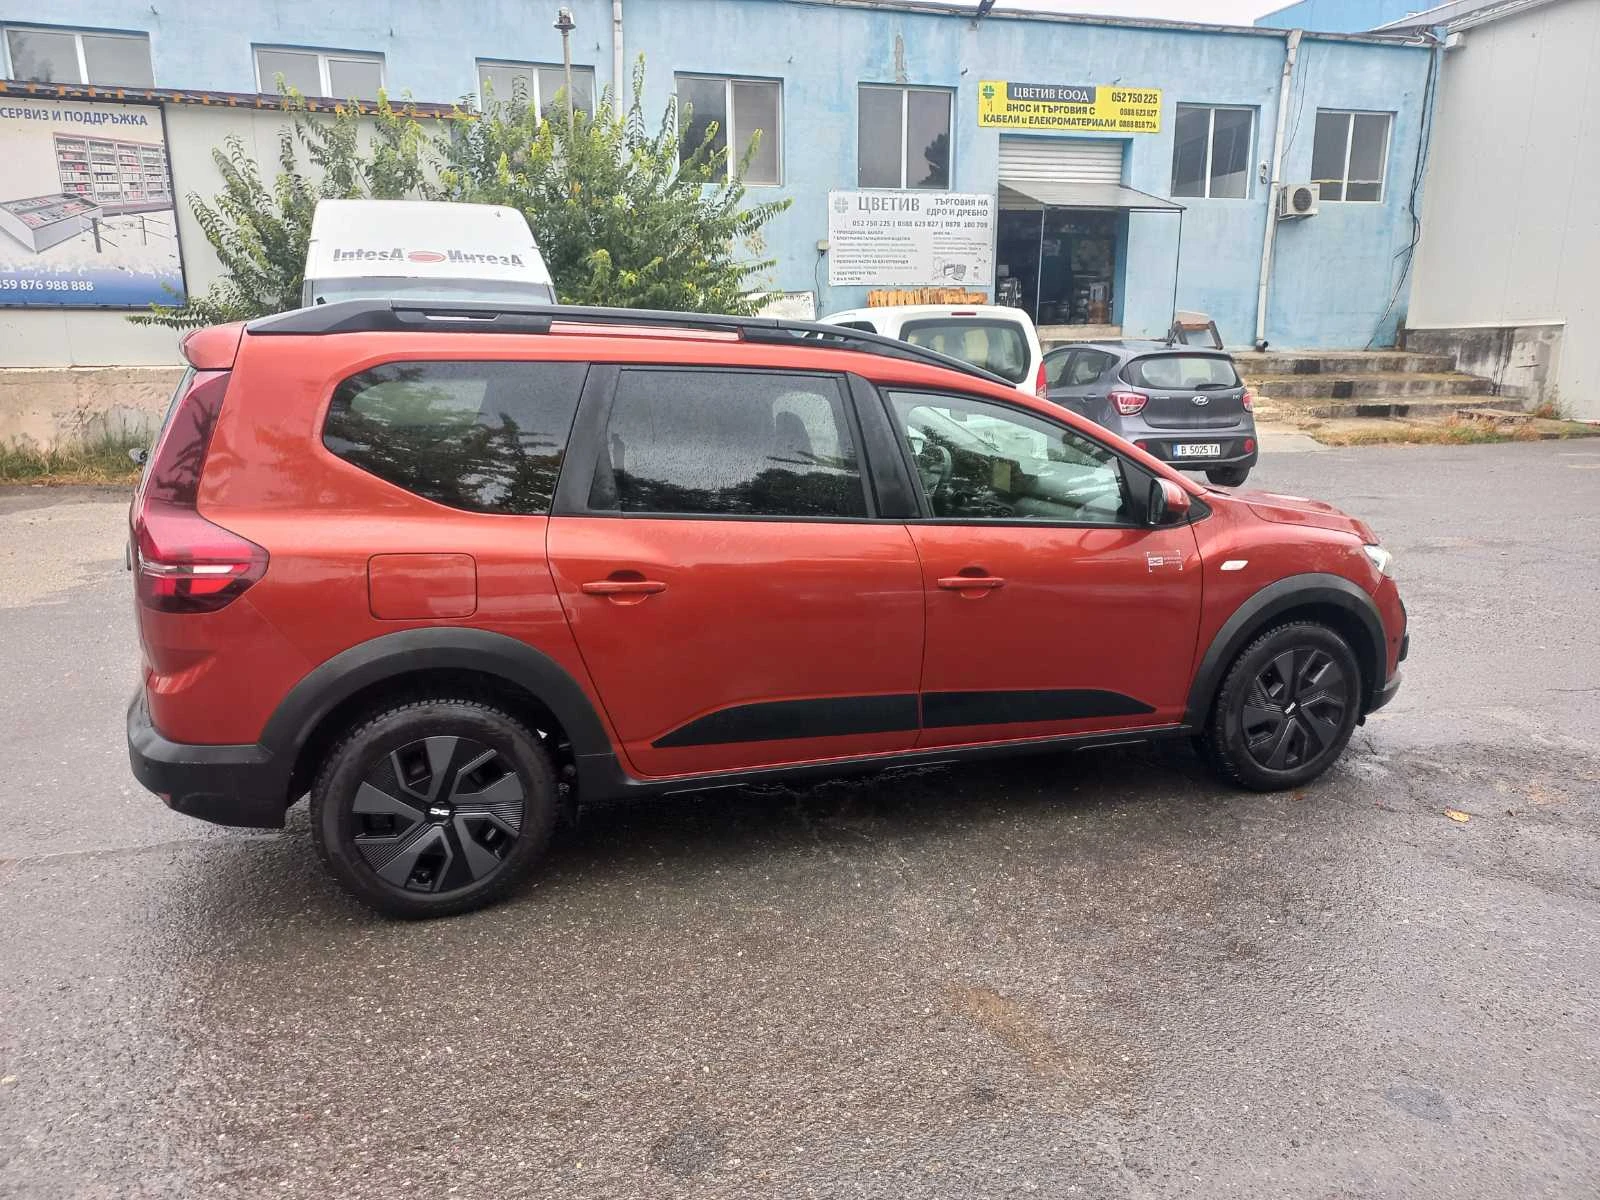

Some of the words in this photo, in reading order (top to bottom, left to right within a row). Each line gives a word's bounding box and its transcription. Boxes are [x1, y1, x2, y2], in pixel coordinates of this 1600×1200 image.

[1014, 87, 1055, 100] ЦВЕТИВ
[1058, 88, 1089, 102] ЕООД
[1111, 91, 1127, 103] 052
[1127, 92, 1143, 103] 750
[1143, 93, 1158, 104] 225
[1006, 103, 1031, 112] ВНОС
[1033, 104, 1040, 113] И
[1042, 105, 1087, 115] ТЪРГОВИЯ
[1089, 106, 1096, 115] С
[0, 107, 49, 121] СЕРВИЗ
[52, 110, 62, 121] И
[64, 111, 148, 126] ПОДДРЪЖКА
[983, 114, 1020, 124] КАБЕЛИ
[1029, 116, 1117, 128] ЕЛЕКРОМАТЕРИАЛИ
[858, 196, 920, 214] ЦВЕТИВ
[935, 197, 976, 207] ТЪРГОВИЯ
[977, 199, 989, 207] НА
[926, 208, 947, 217] ЕДРО
[949, 208, 955, 216] И
[956, 208, 989, 217] ДРЕБНО
[333, 247, 405, 262] IntesA
[447, 249, 526, 267] ИнтезА
[20, 279, 43, 290] 876
[46, 280, 69, 291] 988
[71, 280, 94, 292] 888
[1181, 445, 1187, 454] B
[1190, 445, 1208, 454] 5025
